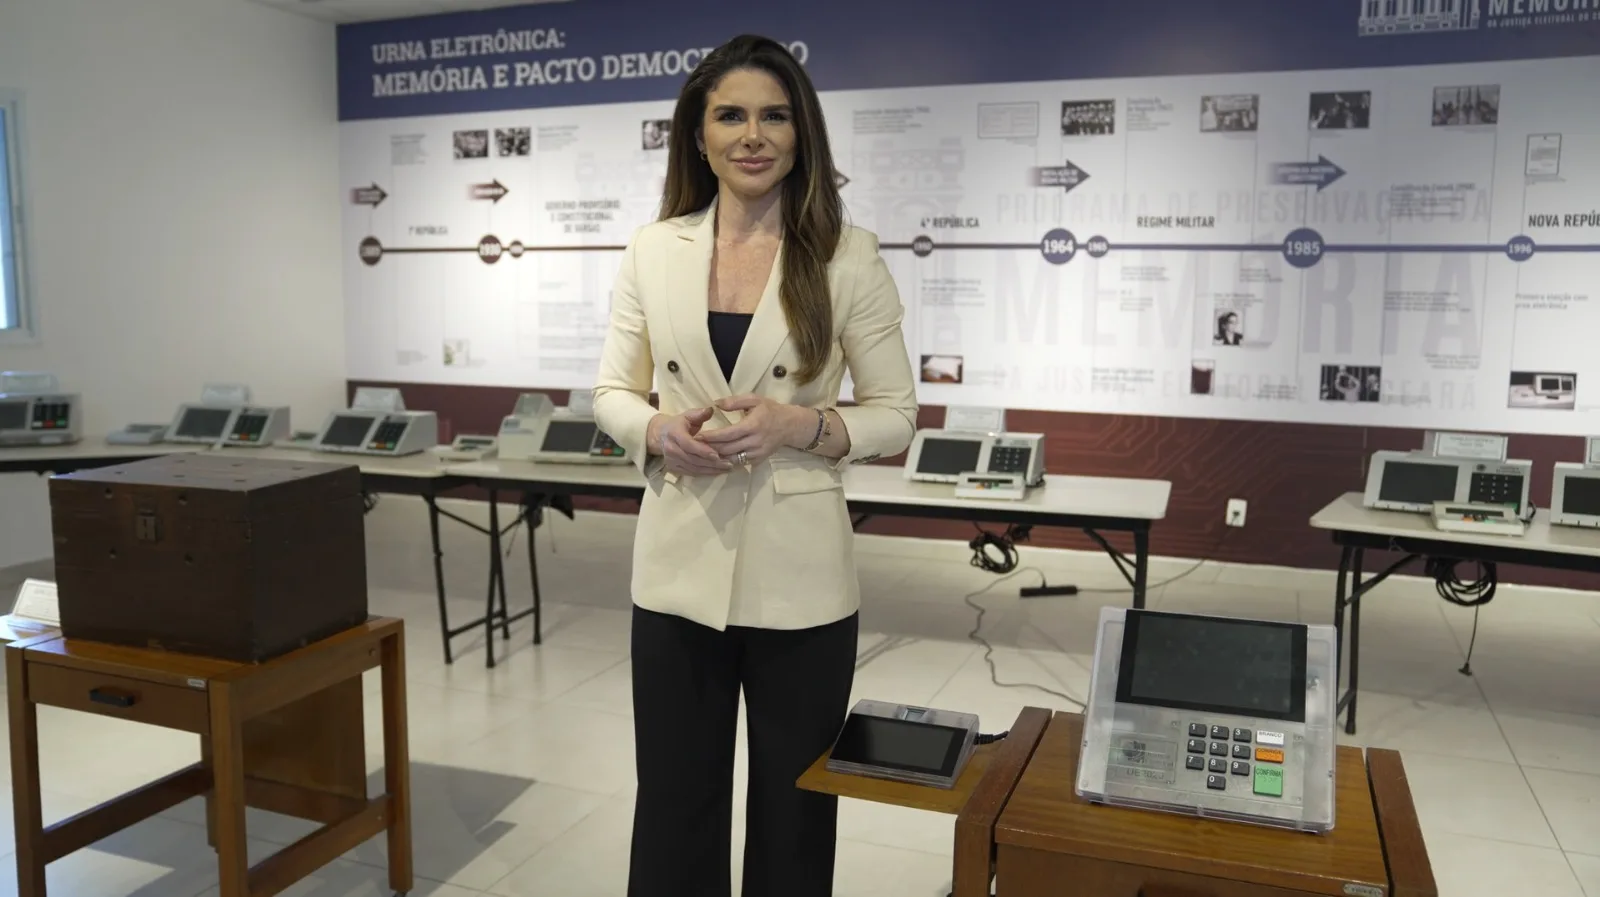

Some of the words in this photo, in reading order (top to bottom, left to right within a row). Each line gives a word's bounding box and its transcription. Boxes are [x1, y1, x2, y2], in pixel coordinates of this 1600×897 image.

[1500, 16, 1532, 28] JUSTIÇA
[1534, 13, 1575, 25] ELEITORAL
[372, 41, 427, 64] URNA
[430, 28, 566, 59] ELETRÔNICA:
[372, 64, 488, 98] MEMÓRIA
[492, 64, 509, 88] E
[515, 57, 596, 87] PACTO
[602, 41, 809, 80] DEMOCO
[932, 214, 980, 229] REPÚBLICA
[1136, 215, 1173, 229] REGIME
[1175, 214, 1216, 228] MILITAR
[1528, 213, 1561, 228] NOVA
[1043, 239, 1074, 255] 1964
[1286, 241, 1321, 256] 1985
[1508, 243, 1532, 255] 1996
[1256, 767, 1281, 777] CONFIRMA
